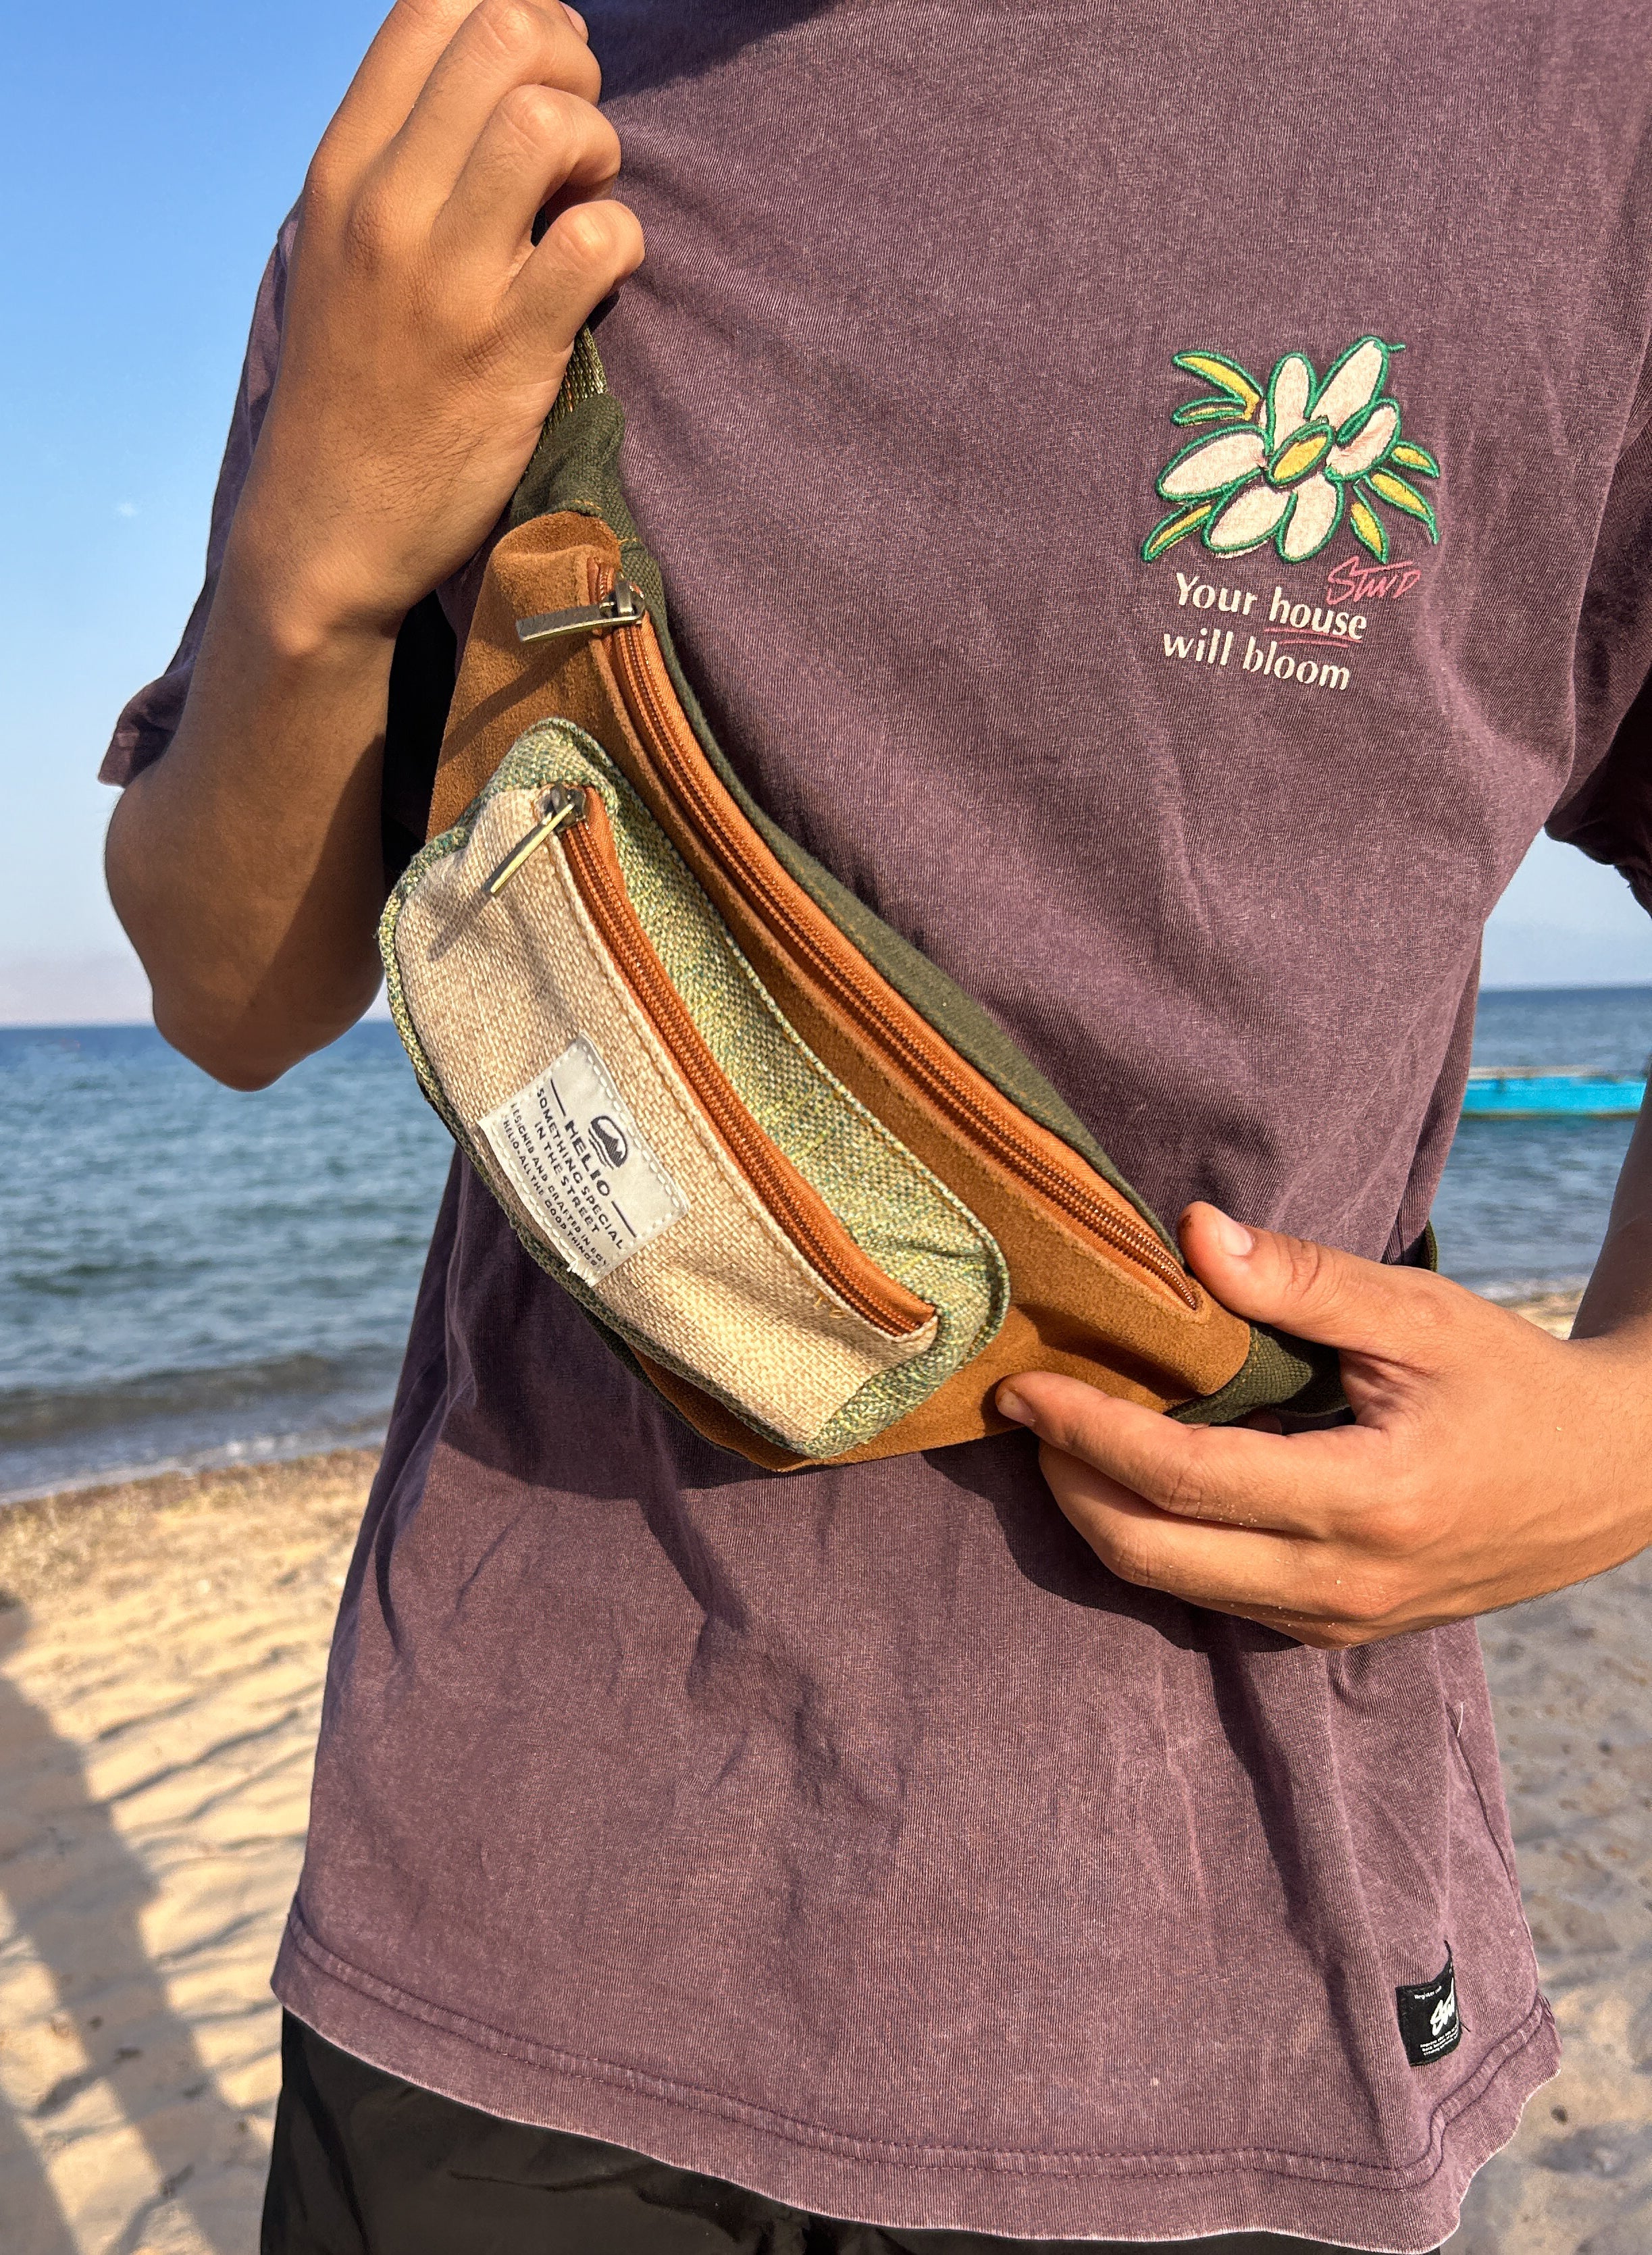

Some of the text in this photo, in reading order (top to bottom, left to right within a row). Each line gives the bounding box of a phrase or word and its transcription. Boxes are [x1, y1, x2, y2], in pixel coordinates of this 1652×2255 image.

[1176, 572, 1367, 640] Your house
[1163, 627, 1350, 690] will bloom
[532, 1157, 548, 1181] AND
[548, 1185, 581, 1233] CRAFTED
[580, 1233, 592, 1247] IN
[534, 1121, 599, 1233] IN THE STREET
[536, 1087, 623, 1249] SOMETHING SPECIAL
[564, 1119, 610, 1196] HELIO
[530, 1174, 544, 1195] THE
[544, 1199, 566, 1229] GOOD
[567, 1230, 597, 1266] THINGS
